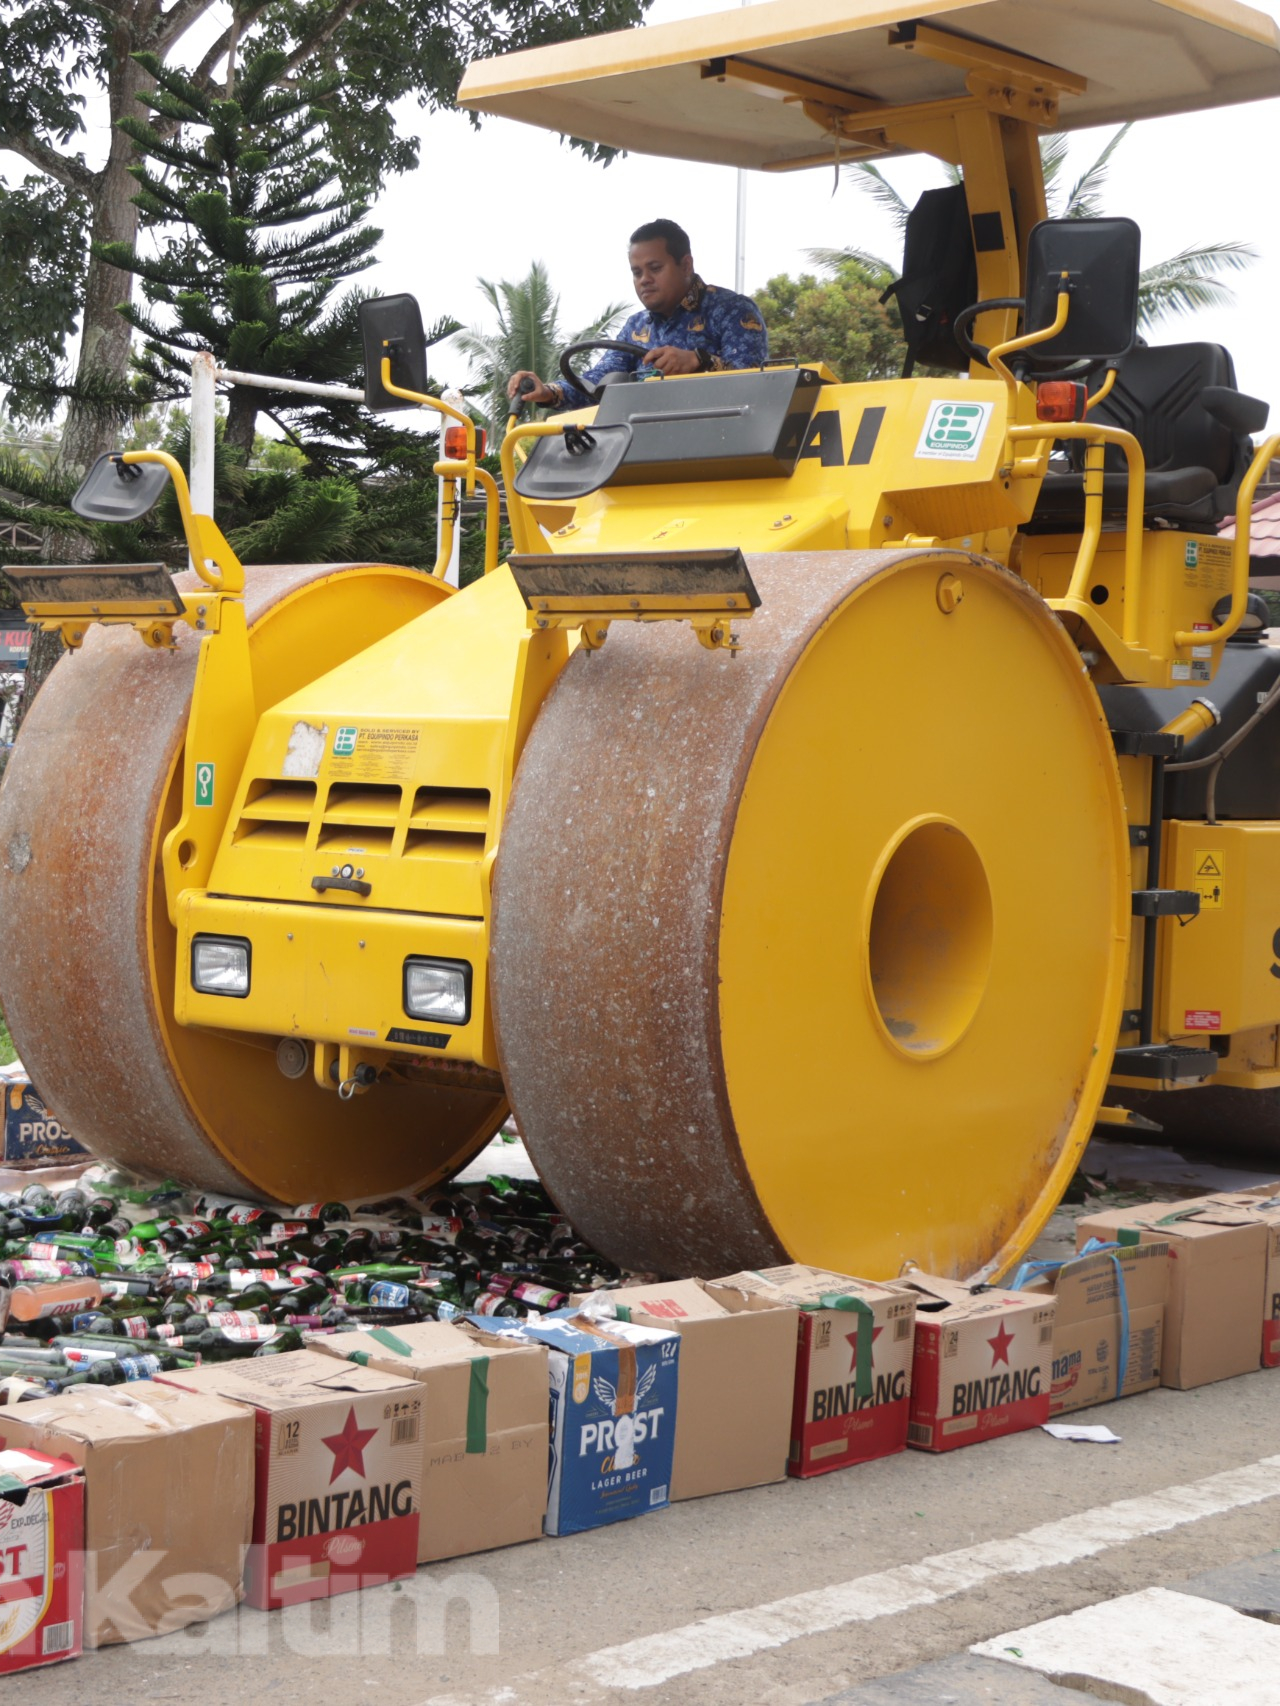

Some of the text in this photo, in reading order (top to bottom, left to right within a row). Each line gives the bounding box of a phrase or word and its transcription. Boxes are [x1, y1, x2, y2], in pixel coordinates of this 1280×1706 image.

[930, 442, 969, 450] EQUIPINDO
[20, 1121, 72, 1143] PROS
[821, 1320, 832, 1336] 12
[949, 1331, 959, 1345] 24
[952, 1366, 1040, 1416] BINTANG
[286, 1421, 300, 1439] 12
[579, 1407, 665, 1457] PROST
[591, 1467, 648, 1491] LAGER BEER
[277, 1480, 413, 1543] BINTANG
[322, 1533, 366, 1558] Pilsener
